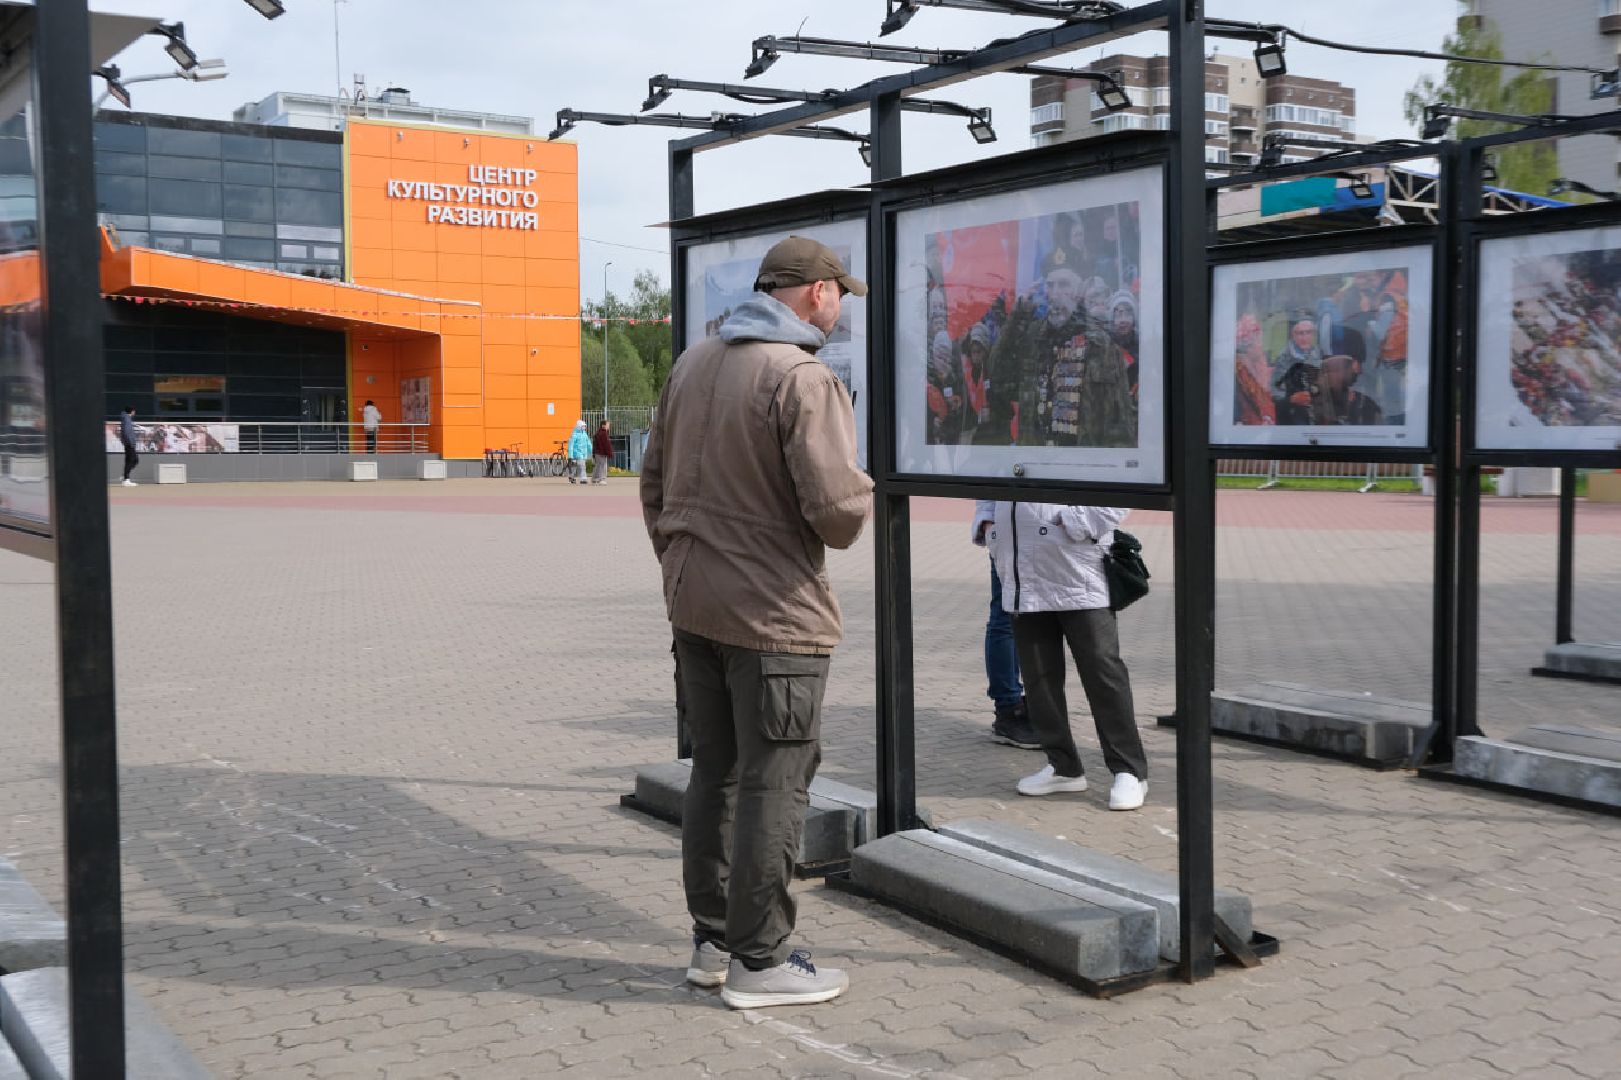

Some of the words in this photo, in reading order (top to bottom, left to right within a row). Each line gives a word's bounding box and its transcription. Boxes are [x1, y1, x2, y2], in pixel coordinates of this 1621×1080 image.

[469, 164, 537, 186] ЦЕНТР
[387, 179, 538, 208] КУЛЬТУРНОГО
[428, 205, 538, 230] РАЗВИТИЯ
